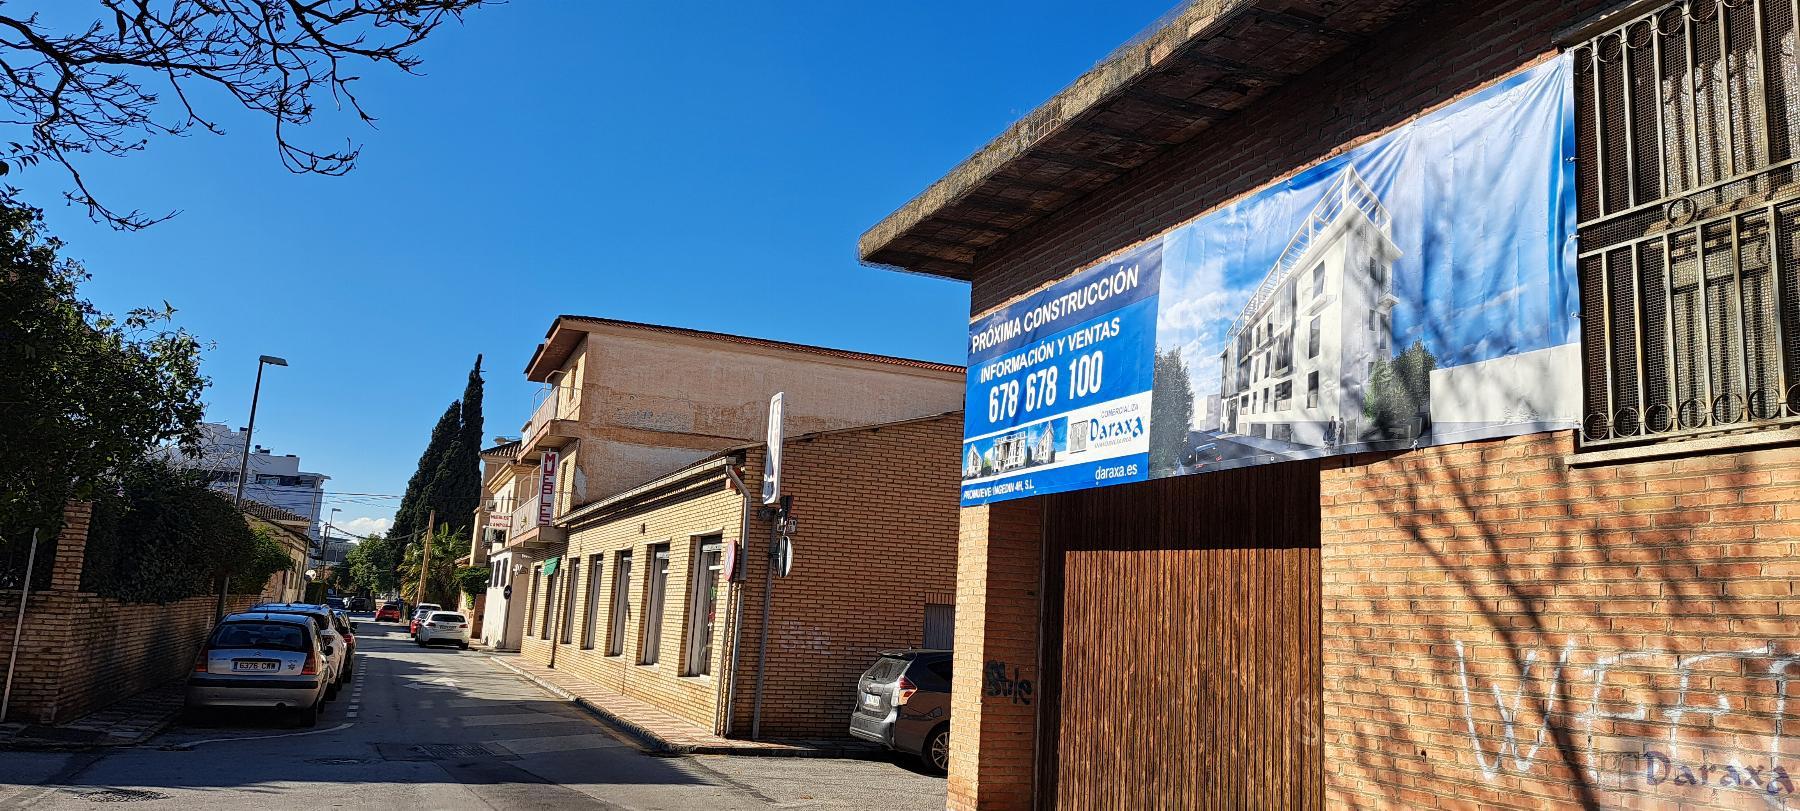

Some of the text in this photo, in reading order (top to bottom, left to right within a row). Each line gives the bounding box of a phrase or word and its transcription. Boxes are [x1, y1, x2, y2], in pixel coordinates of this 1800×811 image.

[972, 264, 1139, 354] PRÓXIMA CONSTRUCCIÓN
[981, 317, 1121, 383] INFORMACIÓN Y VENTAS
[988, 350, 1104, 423] 678 678 100
[1090, 415, 1145, 442] Daraxa
[540, 453, 555, 526] MUEBLES
[1095, 463, 1138, 481] daraxa.es
